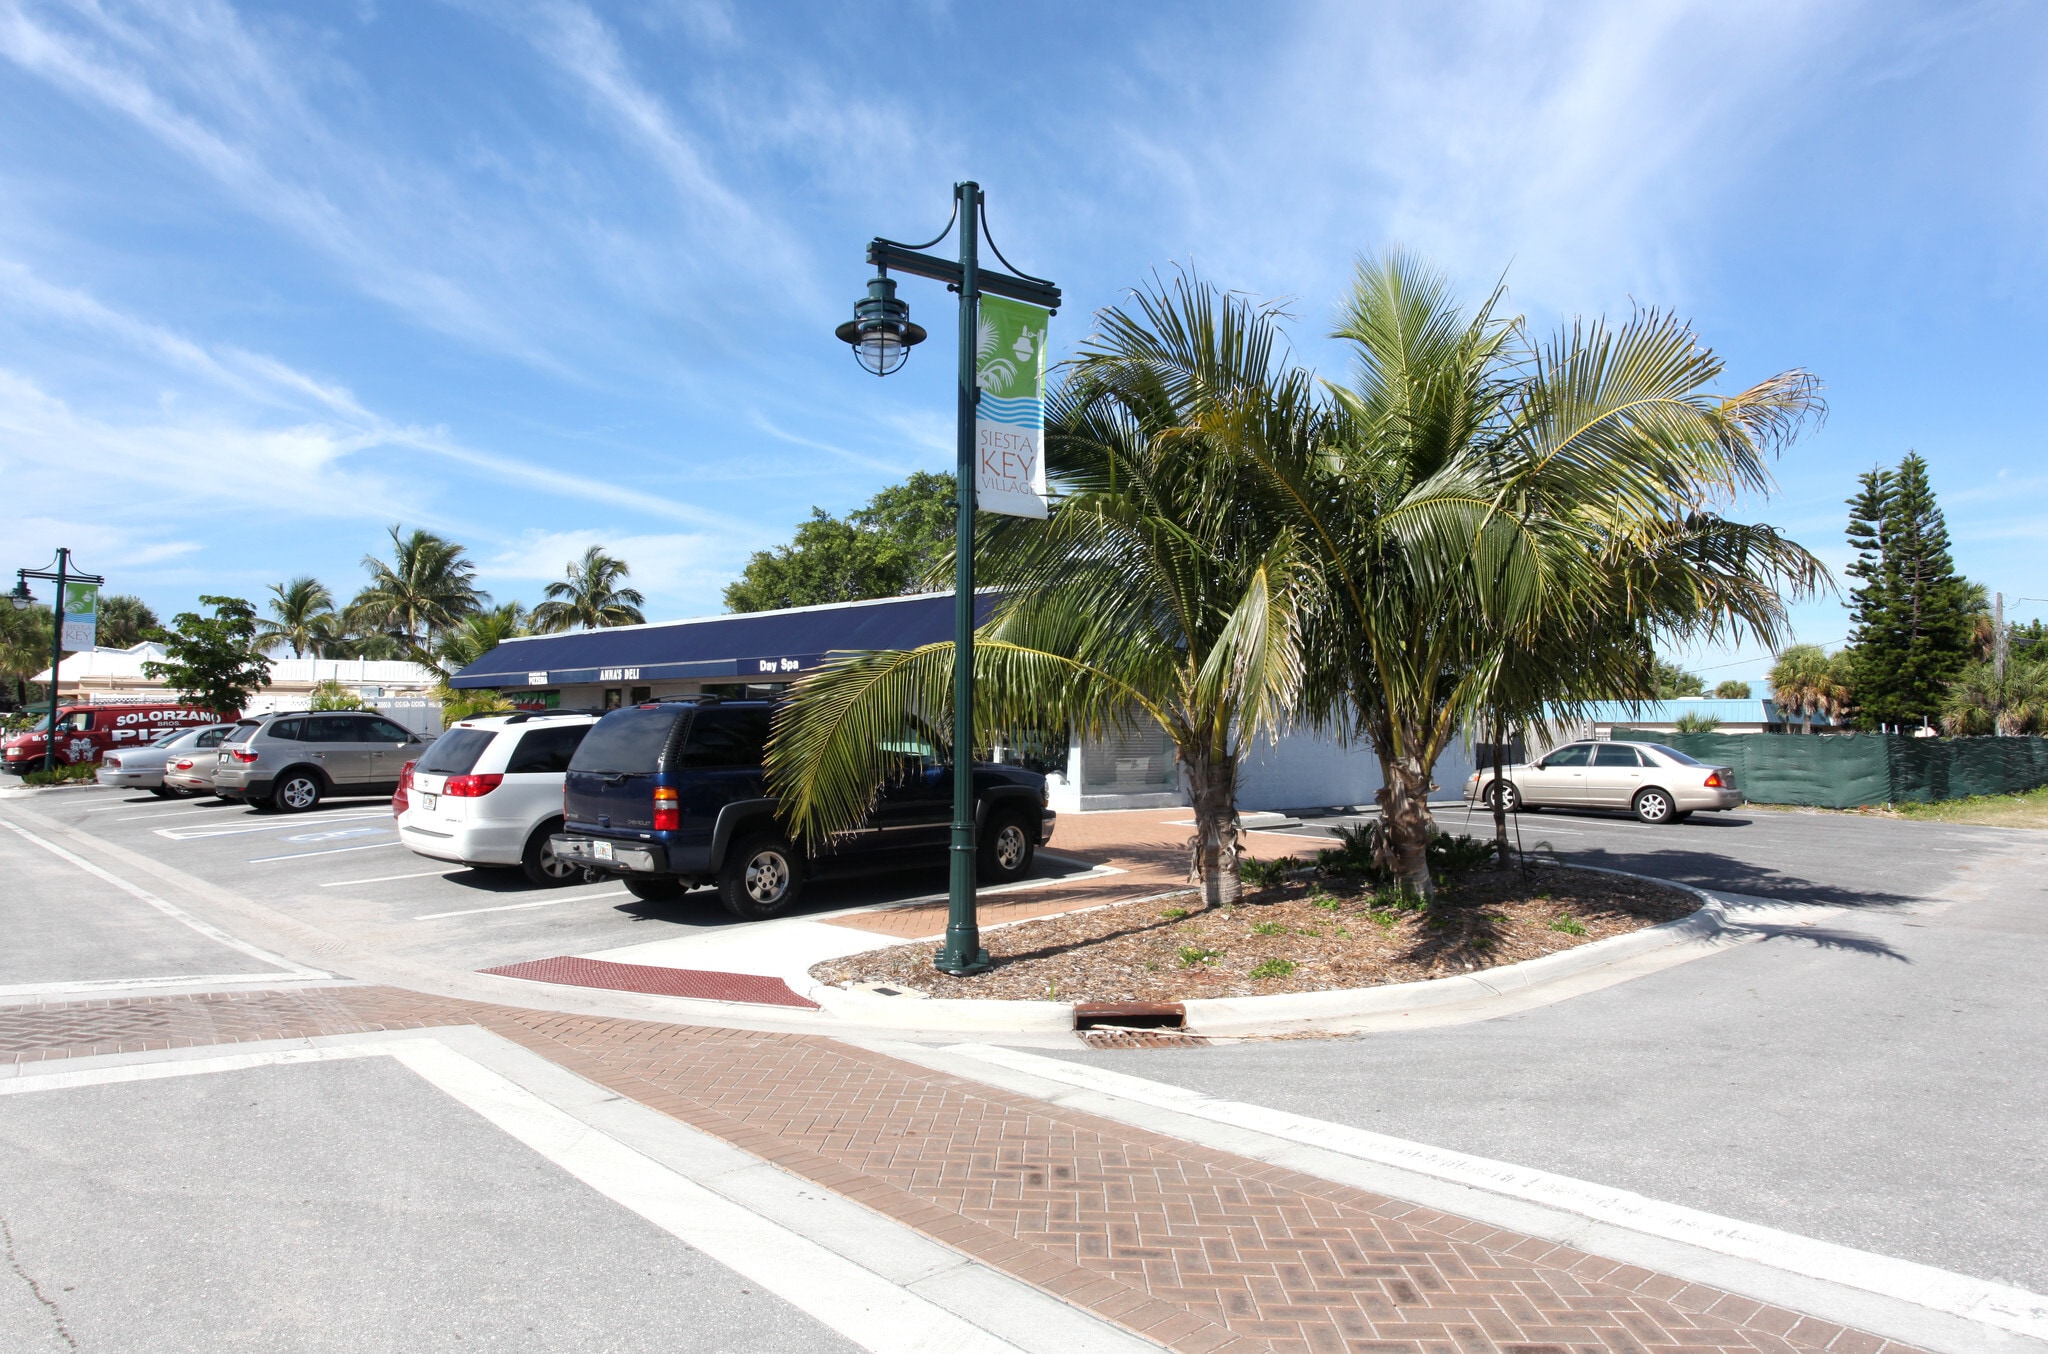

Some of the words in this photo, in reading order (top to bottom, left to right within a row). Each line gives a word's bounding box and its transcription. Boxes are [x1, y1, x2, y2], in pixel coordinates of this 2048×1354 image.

[981, 429, 1033, 452] SIESTA
[981, 448, 1034, 480] KEY
[981, 476, 1036, 496] VILLAGE
[65, 630, 92, 640] KEY
[760, 660, 777, 673] Day
[780, 658, 799, 672] Spa
[600, 669, 622, 680] ANNA'S
[624, 668, 640, 680] DELI
[116, 710, 221, 727] SOLORZANO
[112, 727, 188, 741] PIZ
